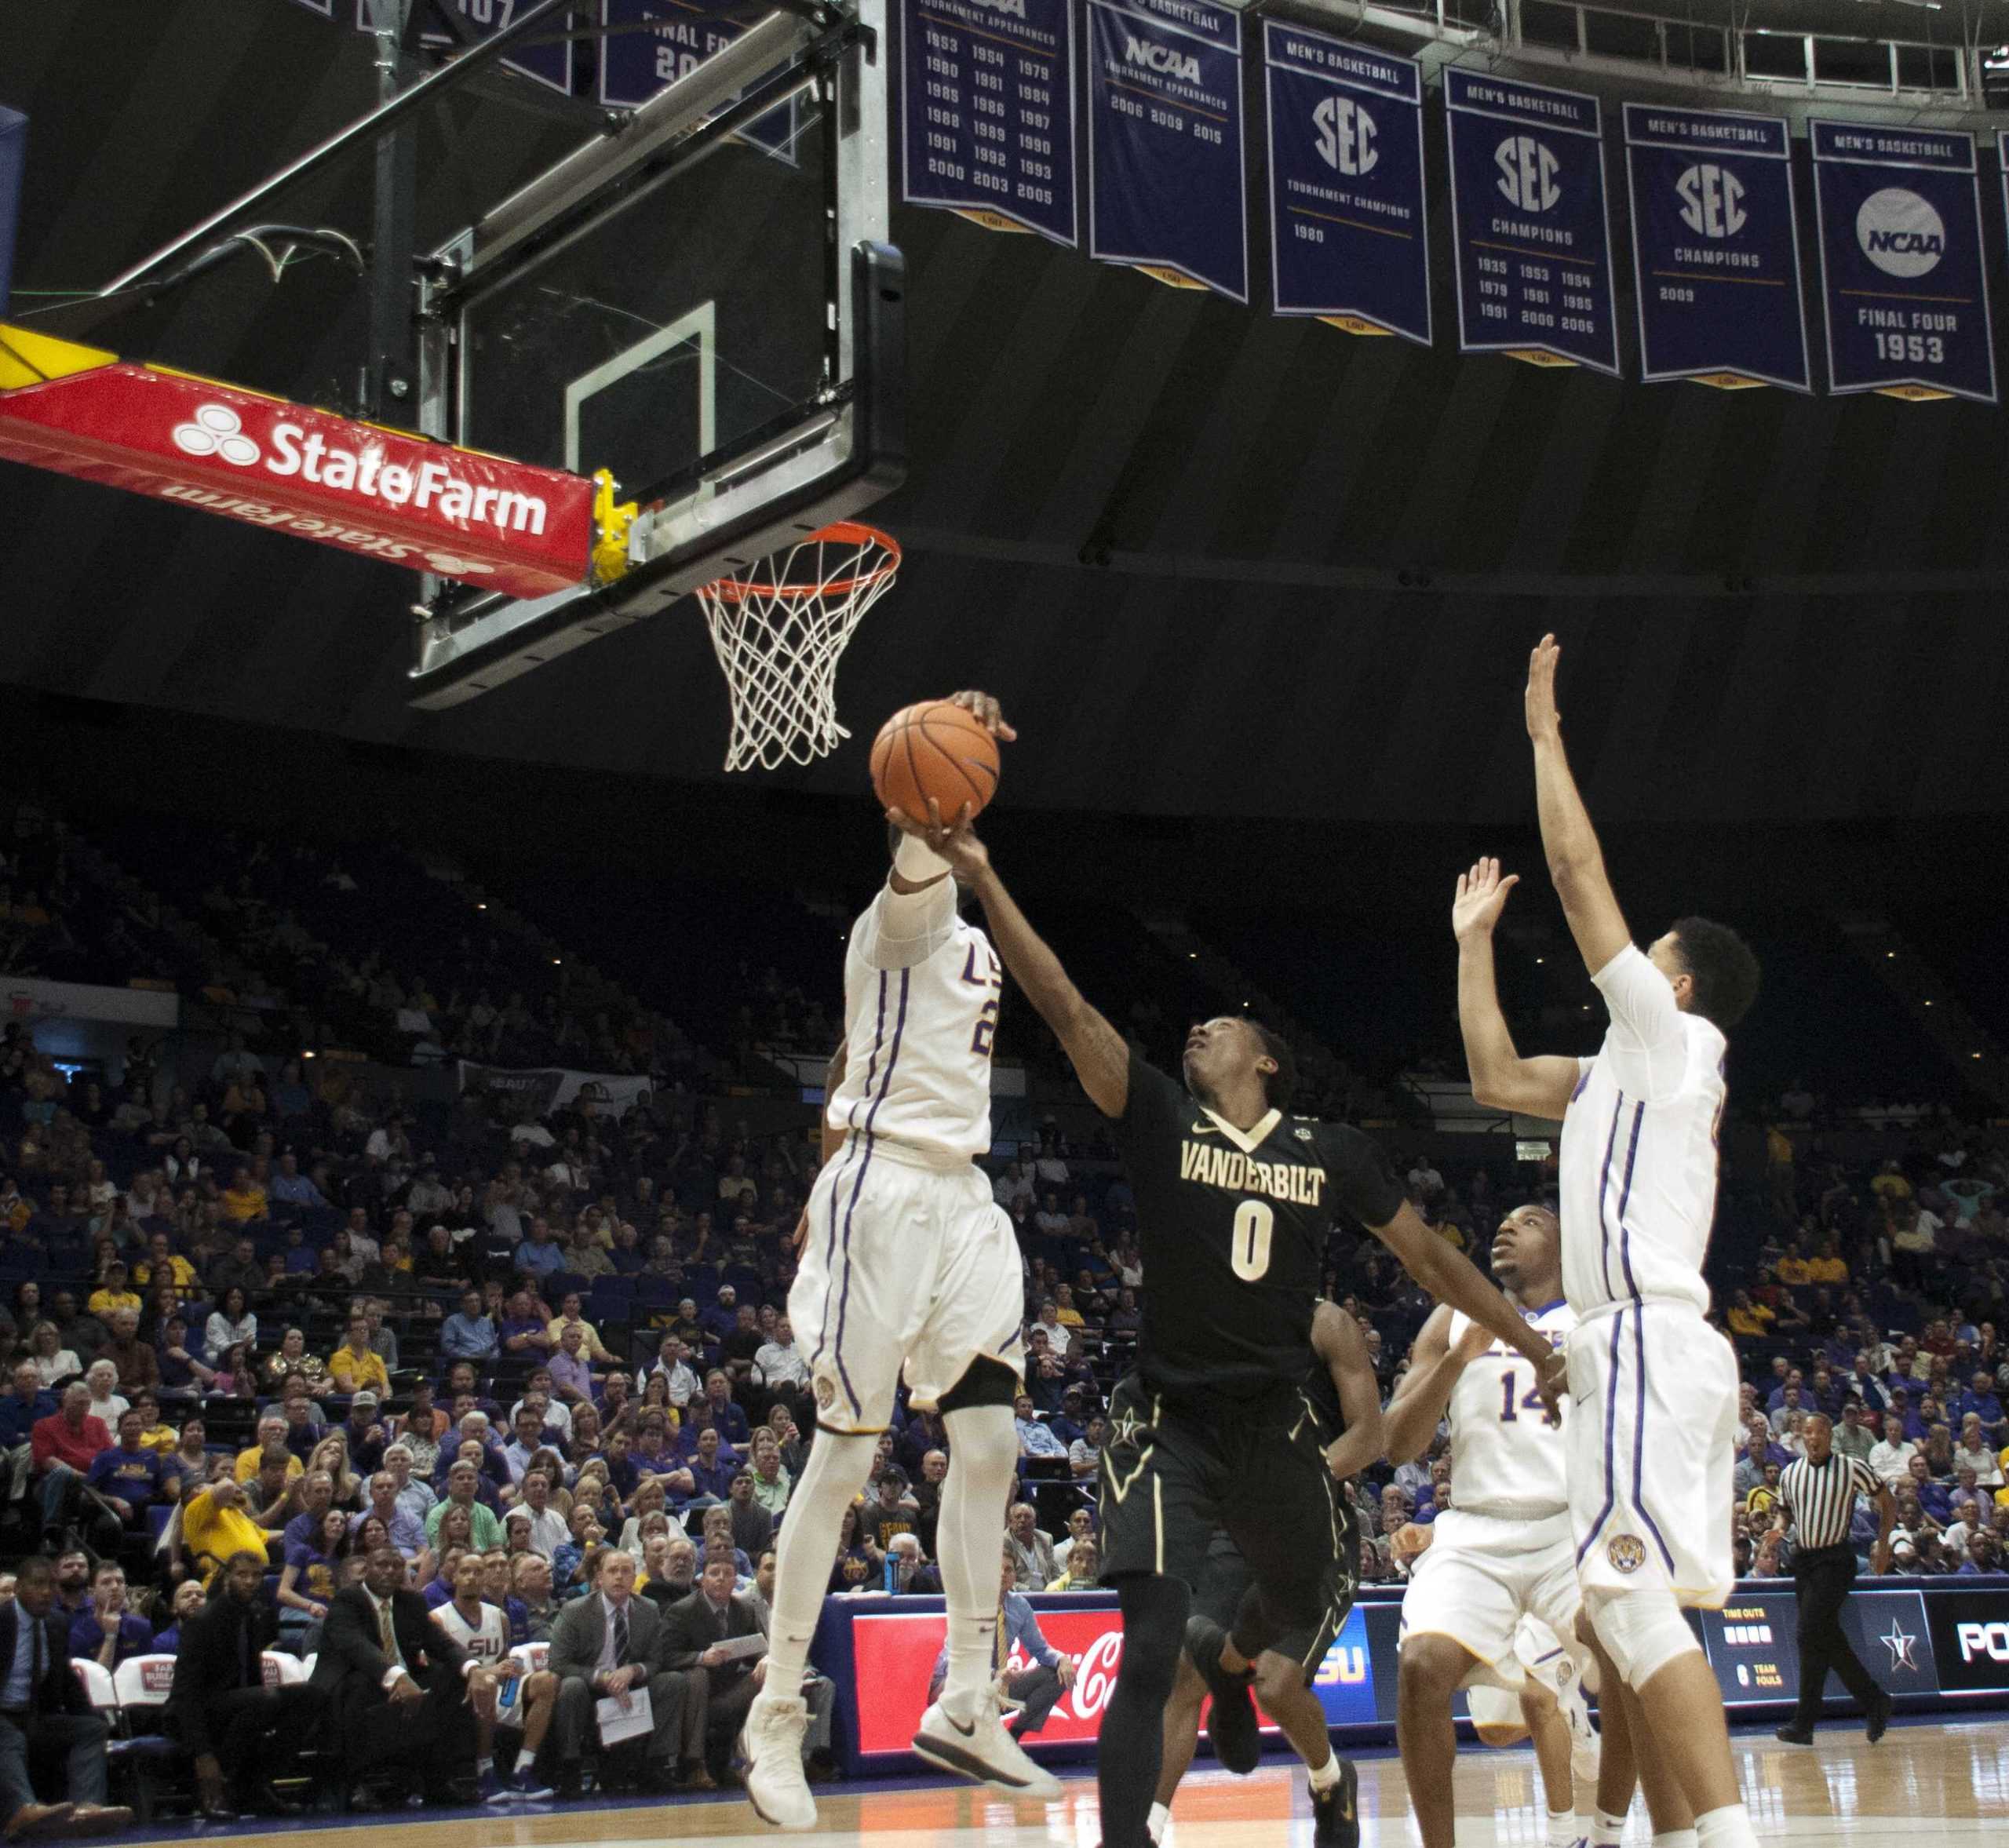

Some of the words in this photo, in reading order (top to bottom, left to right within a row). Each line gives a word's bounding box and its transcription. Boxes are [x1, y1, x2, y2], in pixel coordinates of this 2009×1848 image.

[458, 0, 514, 30] 07
[988, 17, 1056, 46] APPEARANCES
[1150, 0, 1220, 32] BASKETBALL
[927, 31, 957, 53] 1953
[973, 46, 1004, 67] 1954
[1019, 59, 1048, 81] 1979
[1125, 35, 1202, 86] NCAA
[1286, 42, 1323, 64] MEN'S
[1328, 56, 1398, 84] BASKETBALL
[927, 56, 958, 78] 1980
[975, 71, 1002, 92] 1981
[1019, 84, 1049, 106] 1984
[1105, 60, 1163, 89] TOURNAMENT
[1166, 82, 1227, 111] APPEARANCES
[927, 81, 959, 104] 1985
[973, 95, 1004, 117] 1986
[1021, 109, 1050, 129] 1987
[1468, 86, 1504, 104] MEN'S
[1508, 94, 1579, 119] BASKETBALL
[928, 106, 960, 129] 1988
[974, 121, 1005, 142] 1989
[1019, 133, 1052, 155] 1990
[1312, 97, 1378, 176] SEC
[1648, 119, 1687, 136] MEN'S
[1691, 126, 1767, 143] BASKETBALL
[1835, 135, 1873, 151] MEN'S
[1877, 141, 1952, 157] BASKETBALL
[928, 132, 957, 154] 1991
[975, 145, 1006, 168] 1992
[1020, 159, 1052, 180] 1993
[1494, 137, 1561, 212] SEC
[928, 158, 964, 180] 2000
[973, 171, 1008, 193] 2003
[1017, 183, 1052, 205] 2005
[1287, 179, 1351, 206] TOURNAMENT
[1355, 196, 1409, 219] CHAMPIONS
[1675, 164, 1747, 238] SEC
[1294, 224, 1323, 243] 1980
[1493, 218, 1573, 246] CHAMPIONS
[1867, 230, 1943, 257] NCAA
[1674, 248, 1759, 268] CHAMPIONS
[1660, 287, 1694, 302] 2009
[1858, 308, 1906, 330] FINAL
[1912, 312, 1957, 332] FOUR
[1876, 333, 1944, 364] 1953
[1180, 1140, 1325, 1206] VANDERBILT
[1231, 1199, 1274, 1281] 0
[1500, 1370, 1553, 1424] 14
[1723, 1608, 1741, 1620] TIME
[1742, 1607, 1765, 1620] OUTS
[467, 1638, 499, 1657] SU
[1957, 1622, 2009, 1663] PO
[1314, 1646, 1365, 1684] SU
[1753, 1664, 1777, 1674] TEAM
[1756, 1675, 1783, 1687] FOULS
